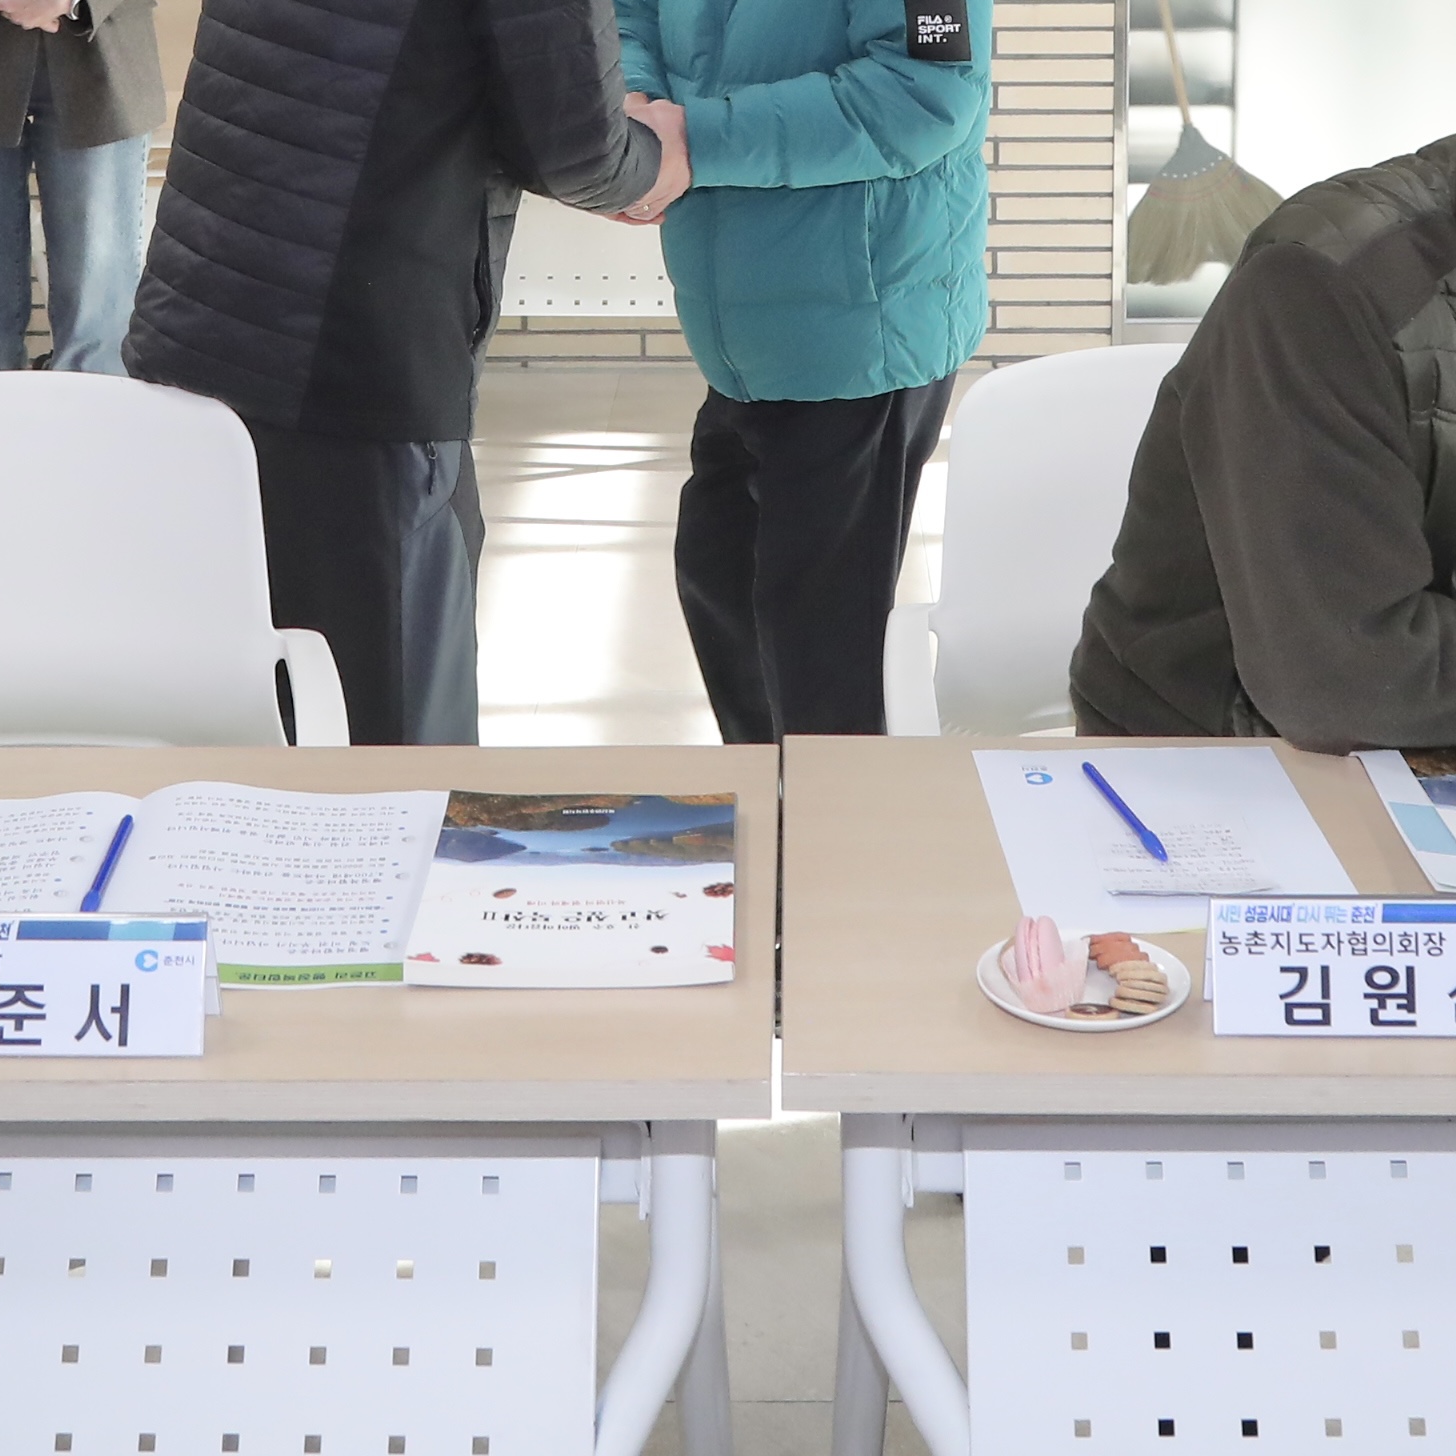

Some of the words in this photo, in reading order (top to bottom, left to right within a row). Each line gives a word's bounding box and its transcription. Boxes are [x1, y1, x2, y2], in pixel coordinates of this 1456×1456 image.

[917, 15, 943, 25] FILA
[917, 24, 961, 34] SPORT
[918, 34, 947, 43] INT.
[1244, 904, 1293, 923] 성공시대
[1296, 905, 1320, 923] 다시
[1350, 905, 1376, 923] 춘천
[1218, 931, 1448, 957] 농촌지도자협의회장
